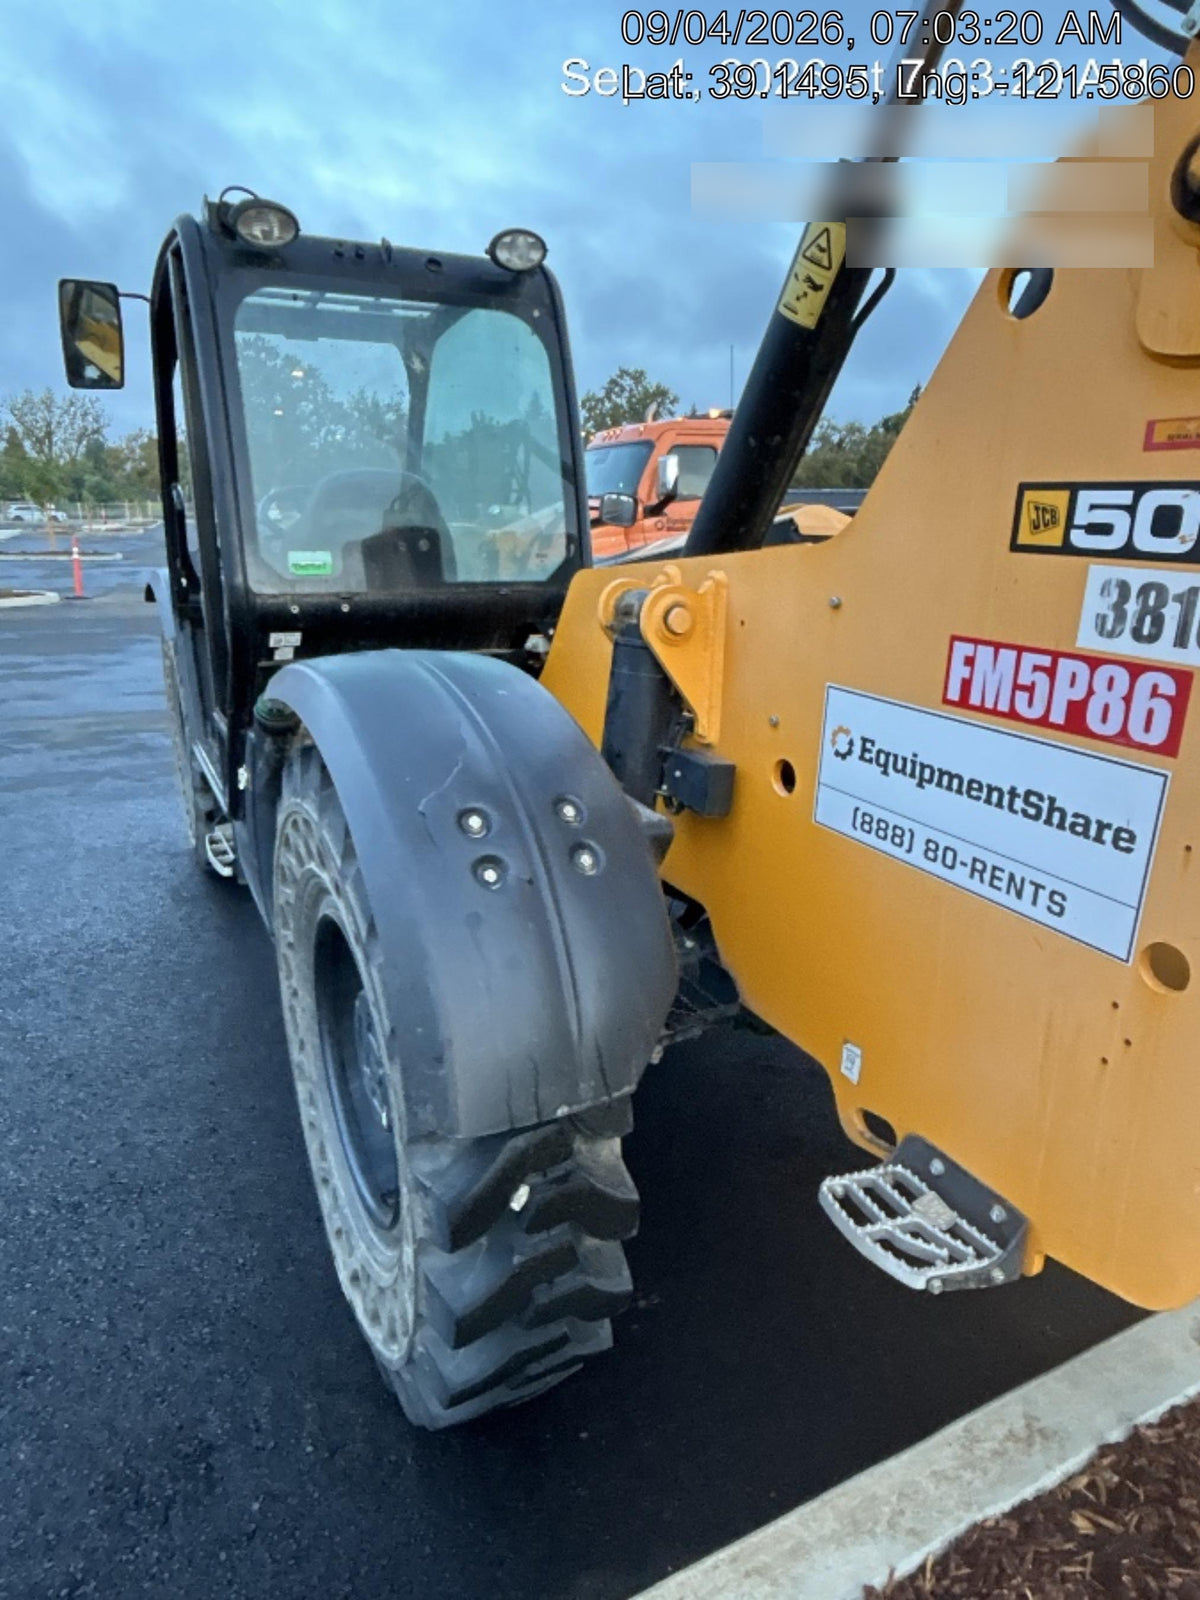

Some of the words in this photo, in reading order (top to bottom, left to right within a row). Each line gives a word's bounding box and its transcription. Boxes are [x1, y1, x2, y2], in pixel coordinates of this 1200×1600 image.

[1031, 502, 1058, 531] JCB
[1095, 576, 1200, 650] 381
[946, 640, 1177, 747] FM5P86
[858, 735, 1137, 854] EquipmentShare
[852, 806, 915, 855] (888)
[924, 838, 1068, 919] 80-RENTS
